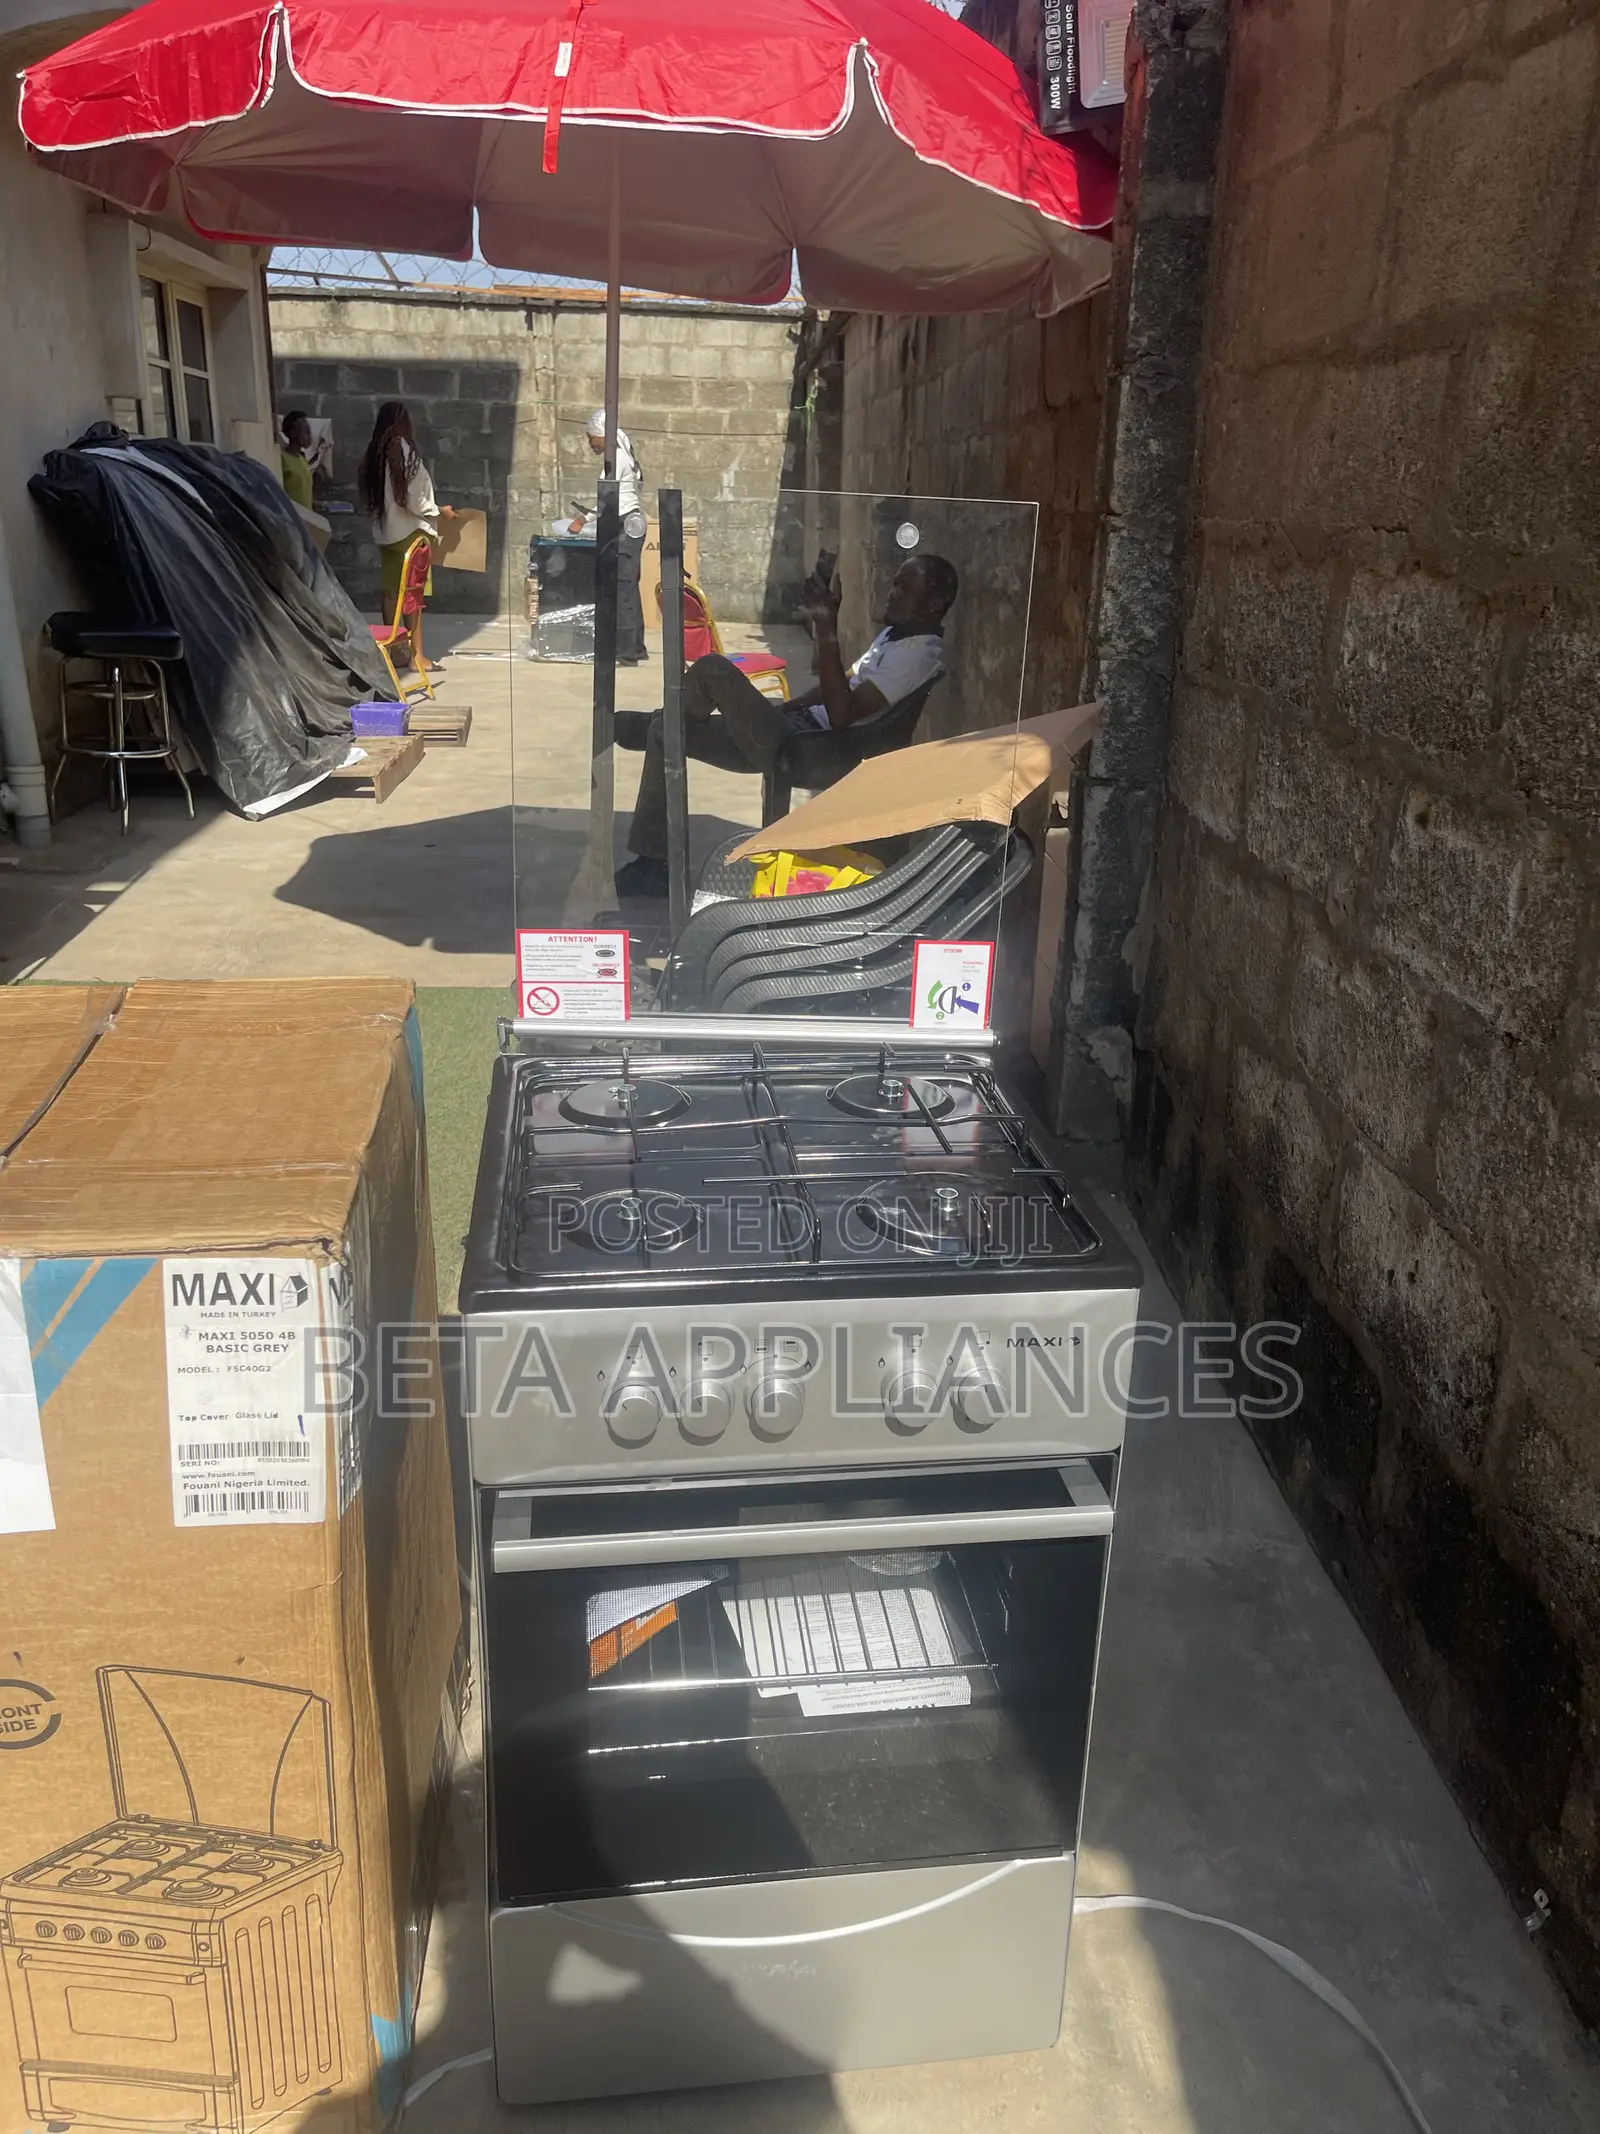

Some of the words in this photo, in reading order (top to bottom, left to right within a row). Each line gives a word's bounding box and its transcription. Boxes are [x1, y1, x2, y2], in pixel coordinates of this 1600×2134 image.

[1065, 4, 1075, 34] Solar
[1066, 37, 1077, 94] Floodlight
[1050, 76, 1061, 110] 300W
[172, 1272, 275, 1306] MAXI
[198, 1332, 235, 1341] MAXI
[240, 1331, 274, 1340] 5050
[278, 1331, 296, 1340] 4B
[1006, 1337, 1062, 1348] MAXI
[206, 1344, 249, 1353] BASIC
[253, 1343, 289, 1353] GREY
[177, 1366, 213, 1374] MODEL
[178, 1414, 197, 1422] Top
[200, 1413, 229, 1421] Cover
[180, 1460, 201, 1468] SERI
[182, 1470, 255, 1479] www.fouani.com
[183, 1481, 220, 1490] Fouani
[224, 1479, 263, 1489] Nigeria
[267, 1478, 310, 1487] Limited.
